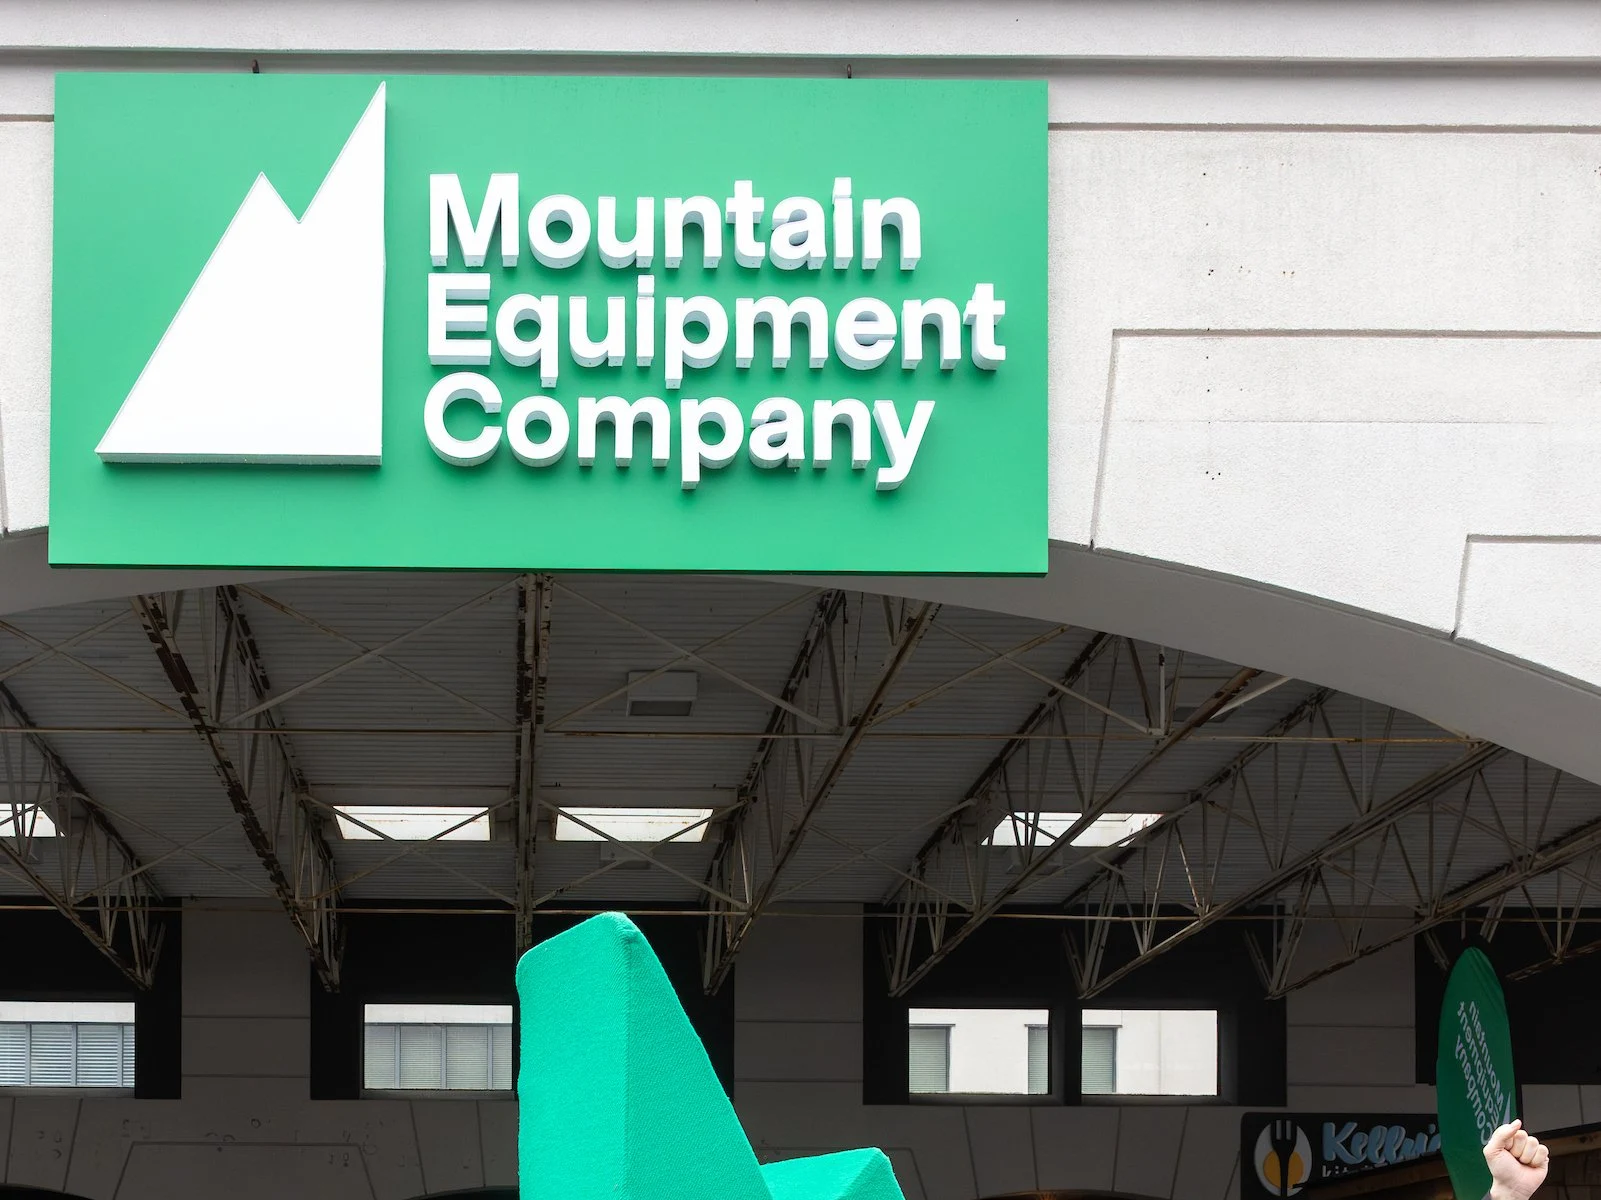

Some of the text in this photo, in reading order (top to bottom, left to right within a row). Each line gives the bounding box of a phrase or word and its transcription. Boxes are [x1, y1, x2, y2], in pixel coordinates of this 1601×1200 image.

[429, 173, 921, 270] Mountain
[428, 273, 1006, 389] Equipment
[424, 372, 936, 490] Company
